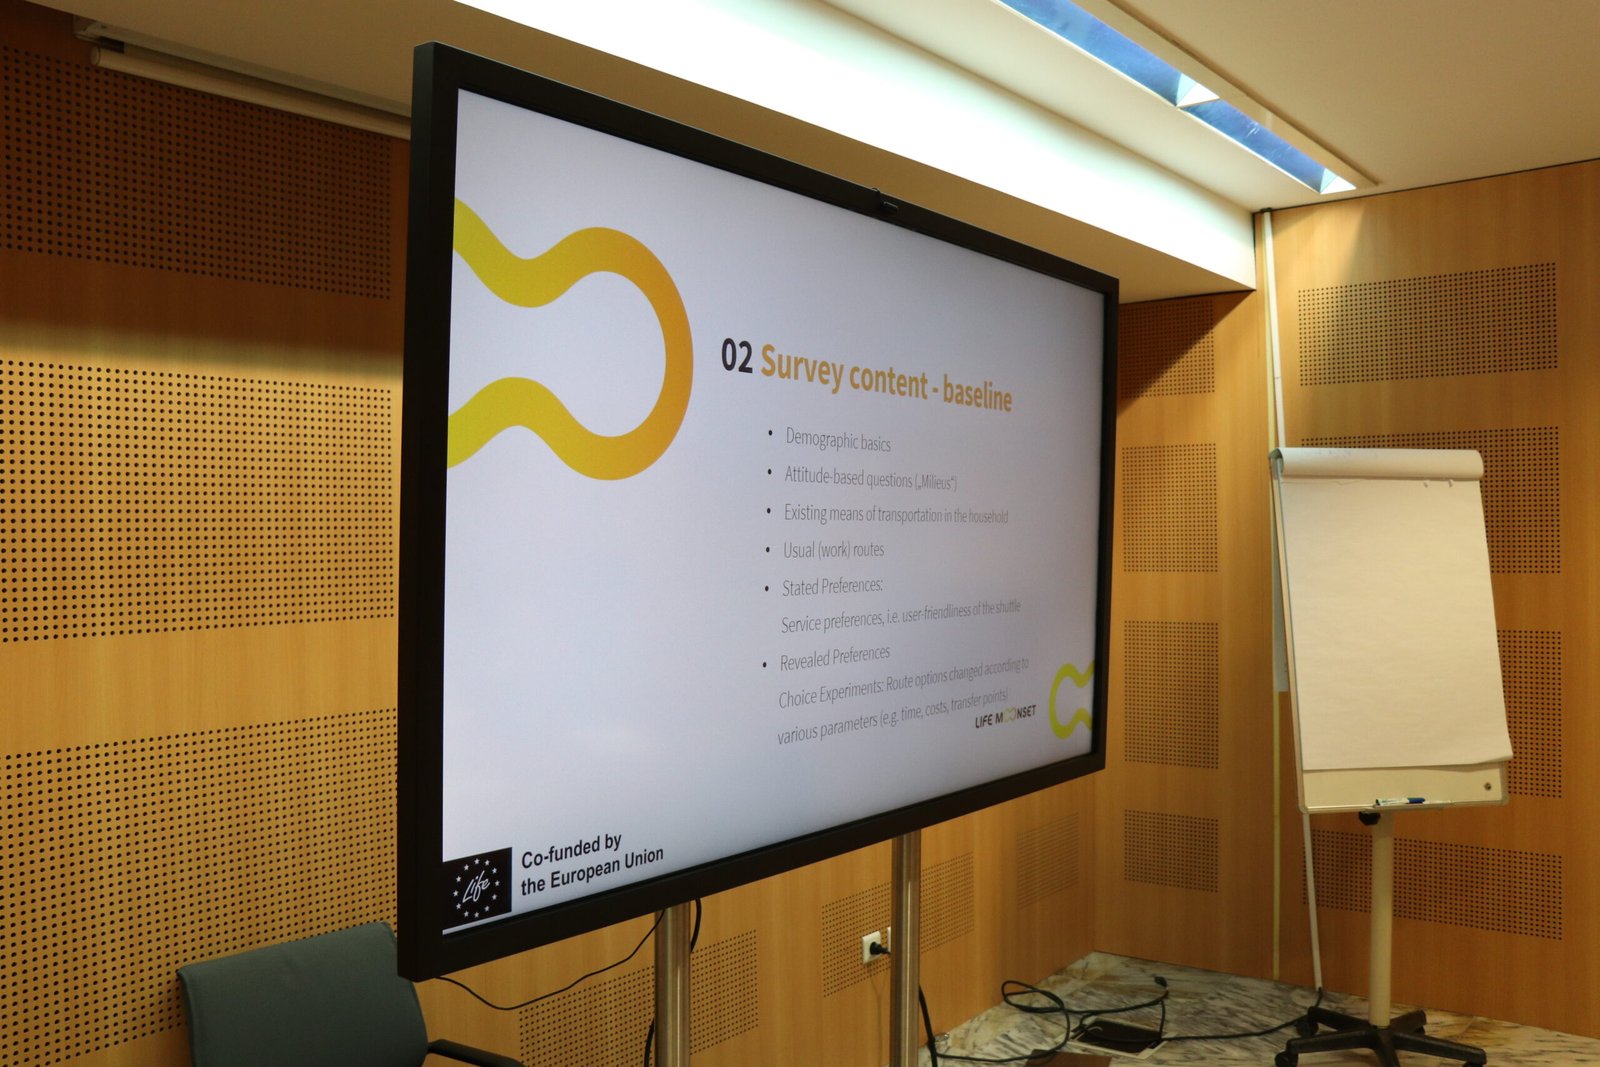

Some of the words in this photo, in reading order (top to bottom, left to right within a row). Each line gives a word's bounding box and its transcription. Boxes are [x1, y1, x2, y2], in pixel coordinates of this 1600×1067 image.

[721, 338, 753, 373] 02
[760, 343, 845, 395] Survey
[849, 365, 929, 400] content
[943, 373, 1013, 412] baseline
[786, 426, 859, 452] Demographic
[861, 433, 892, 453] basics
[785, 465, 865, 486] Attitude-based
[866, 472, 913, 492] questions
[784, 503, 828, 526] Existing
[829, 510, 864, 522] means
[866, 505, 878, 522] of
[878, 506, 943, 526] transportation
[944, 508, 953, 523] in
[954, 507, 968, 523] the
[968, 508, 1009, 524] household
[783, 540, 815, 559] Usual
[817, 540, 851, 560] (work)
[853, 543, 885, 557] routes
[782, 577, 819, 597] Stated
[821, 576, 884, 594] Preferences:
[781, 615, 822, 634] Service
[823, 611, 885, 635] preferences,
[902, 604, 972, 623] user-friendliness
[972, 602, 982, 616] of
[982, 601, 996, 615] the
[780, 649, 830, 671] Revealed
[833, 646, 891, 665] Preferences
[778, 689, 818, 709] Choice
[819, 681, 885, 705] Experiments:
[886, 675, 914, 692] Route
[914, 671, 949, 690] options
[948, 662, 984, 682] changed
[777, 725, 819, 745] various
[820, 714, 879, 741] parameters
[880, 709, 900, 728] (e.g.
[901, 704, 924, 721] time,
[925, 699, 950, 717] costs,
[951, 692, 982, 711] transfer
[975, 714, 993, 729] LIFE
[521, 837, 600, 869] Co-funded
[605, 833, 622, 851] by
[462, 870, 491, 904] Life
[520, 877, 546, 896] the
[550, 860, 621, 889] European
[625, 848, 664, 869] Union
